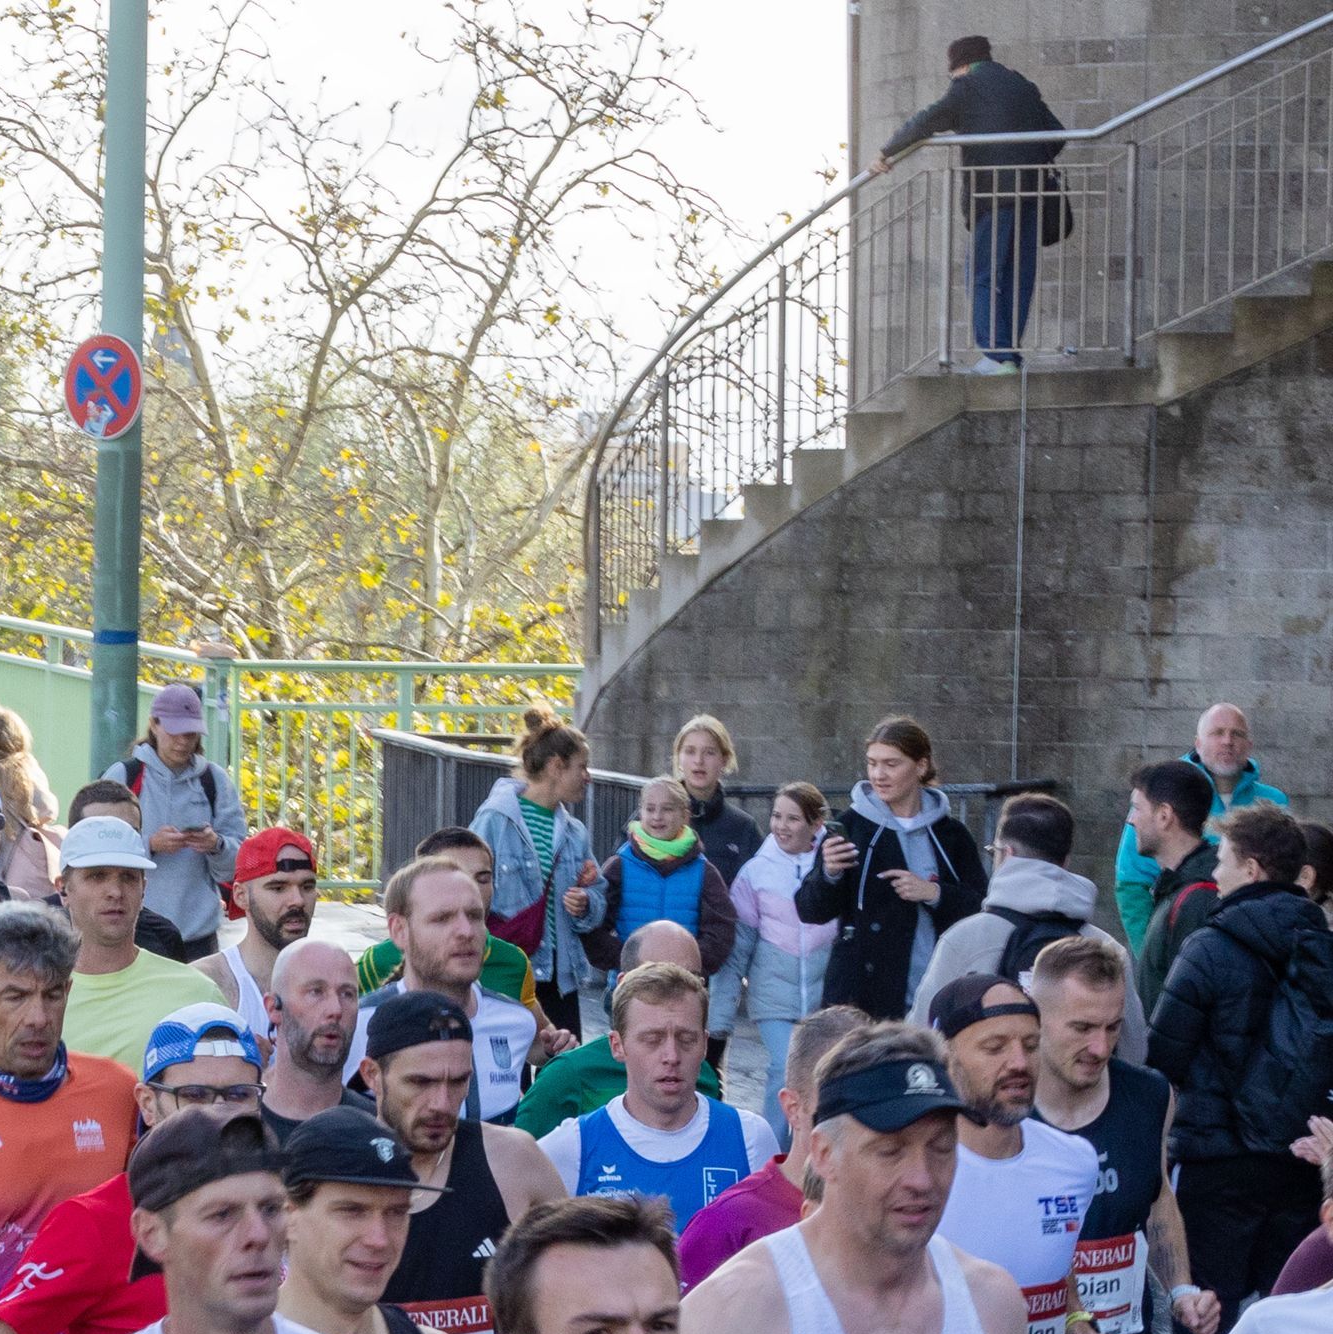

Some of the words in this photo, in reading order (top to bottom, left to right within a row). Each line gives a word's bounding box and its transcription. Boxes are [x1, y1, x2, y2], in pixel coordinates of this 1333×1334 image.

[1038, 1195, 1079, 1216] TSE
[1071, 1242, 1135, 1269] ENERALI
[1077, 1276, 1121, 1297] bian
[408, 1305, 489, 1330] ENERALI
